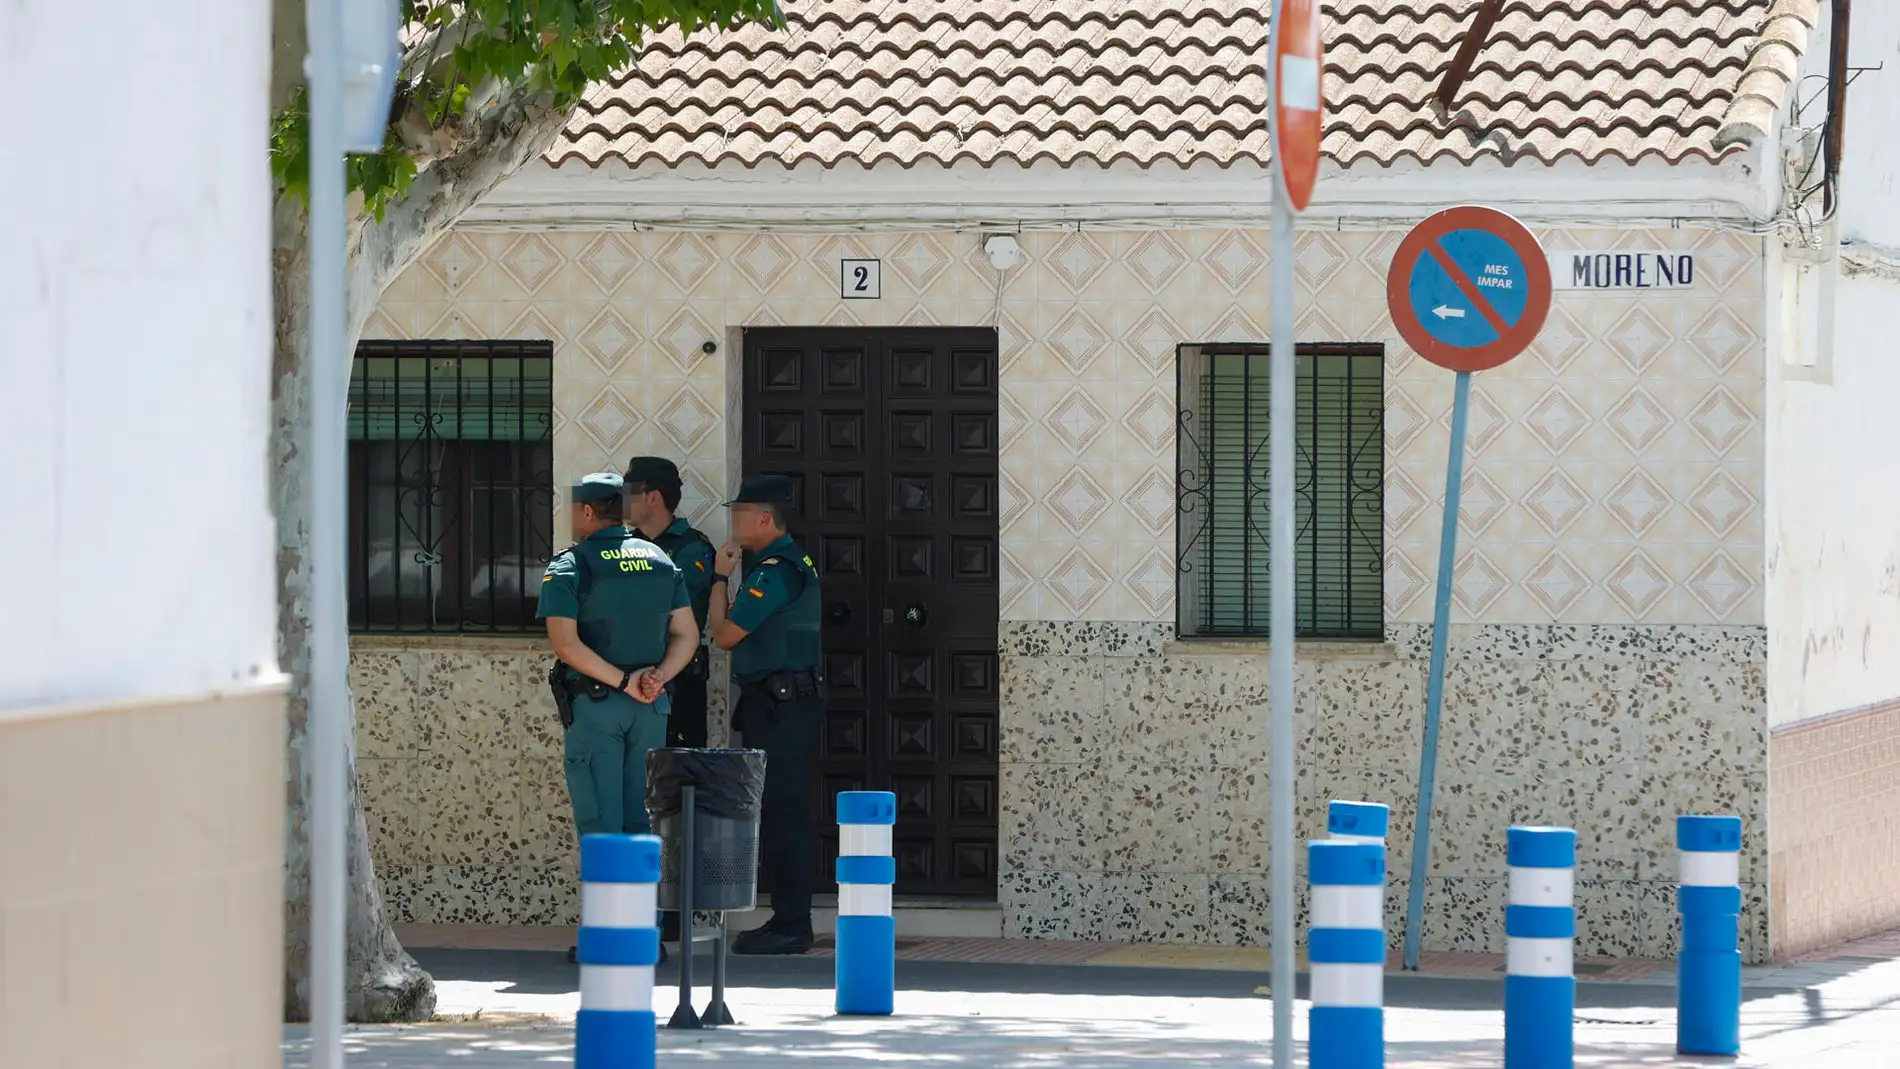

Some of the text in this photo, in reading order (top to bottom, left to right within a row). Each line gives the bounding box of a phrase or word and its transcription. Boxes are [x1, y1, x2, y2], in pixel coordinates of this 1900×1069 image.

[1484, 264, 1509, 276] MES
[1573, 253, 1693, 288] MORENO
[853, 266, 869, 291] 2
[1477, 275, 1513, 290] IMPAR
[600, 547, 658, 560] GUARDIA
[619, 559, 653, 572] CIVIL
